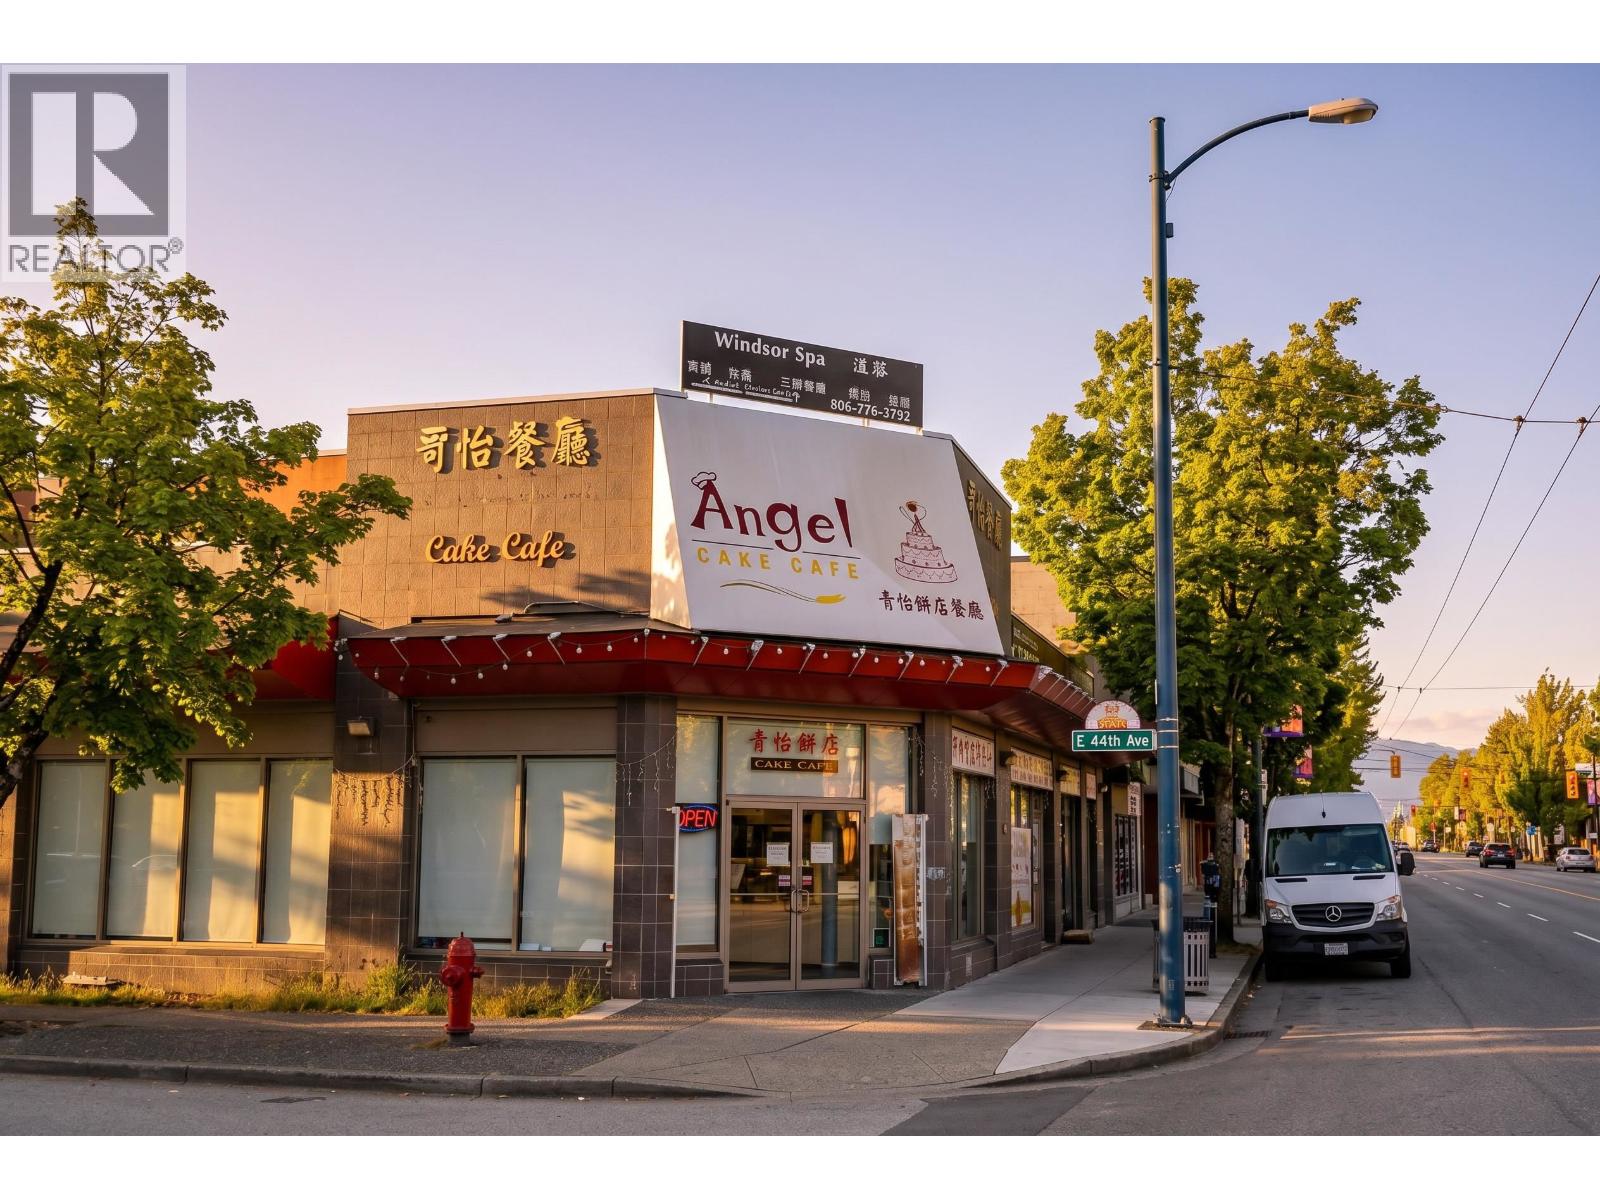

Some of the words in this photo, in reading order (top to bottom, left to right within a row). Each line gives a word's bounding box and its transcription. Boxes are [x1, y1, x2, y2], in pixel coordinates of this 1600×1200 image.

[714, 331, 789, 359] Windsor
[795, 347, 826, 368] Spa
[830, 398, 911, 422] 806-776-3792
[690, 479, 853, 553] Angel
[425, 534, 491, 563] Cake
[501, 530, 565, 567] Cafe
[697, 547, 771, 570] CAKE
[790, 557, 860, 580] CAFE
[1076, 734, 1085, 748] E
[1090, 734, 1120, 747] 44th
[1126, 734, 1149, 747] Ave
[755, 759, 792, 769] CAKE
[797, 760, 834, 771] CAFE
